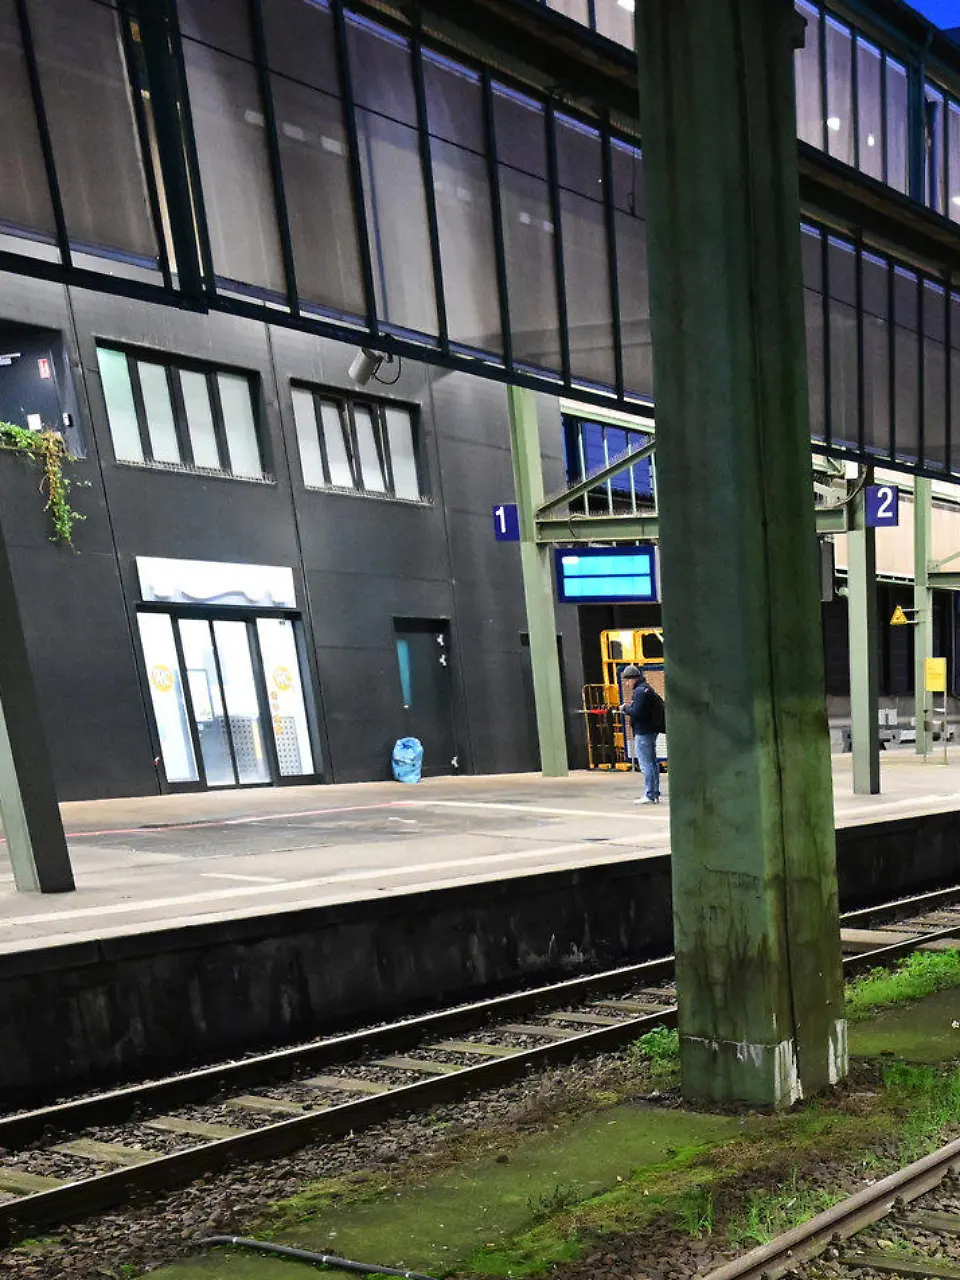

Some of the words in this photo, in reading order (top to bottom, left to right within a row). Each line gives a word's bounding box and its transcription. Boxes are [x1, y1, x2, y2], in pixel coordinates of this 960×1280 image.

[877, 487, 893, 518] 2
[496, 506, 506, 533] 1
[152, 669, 170, 686] WC
